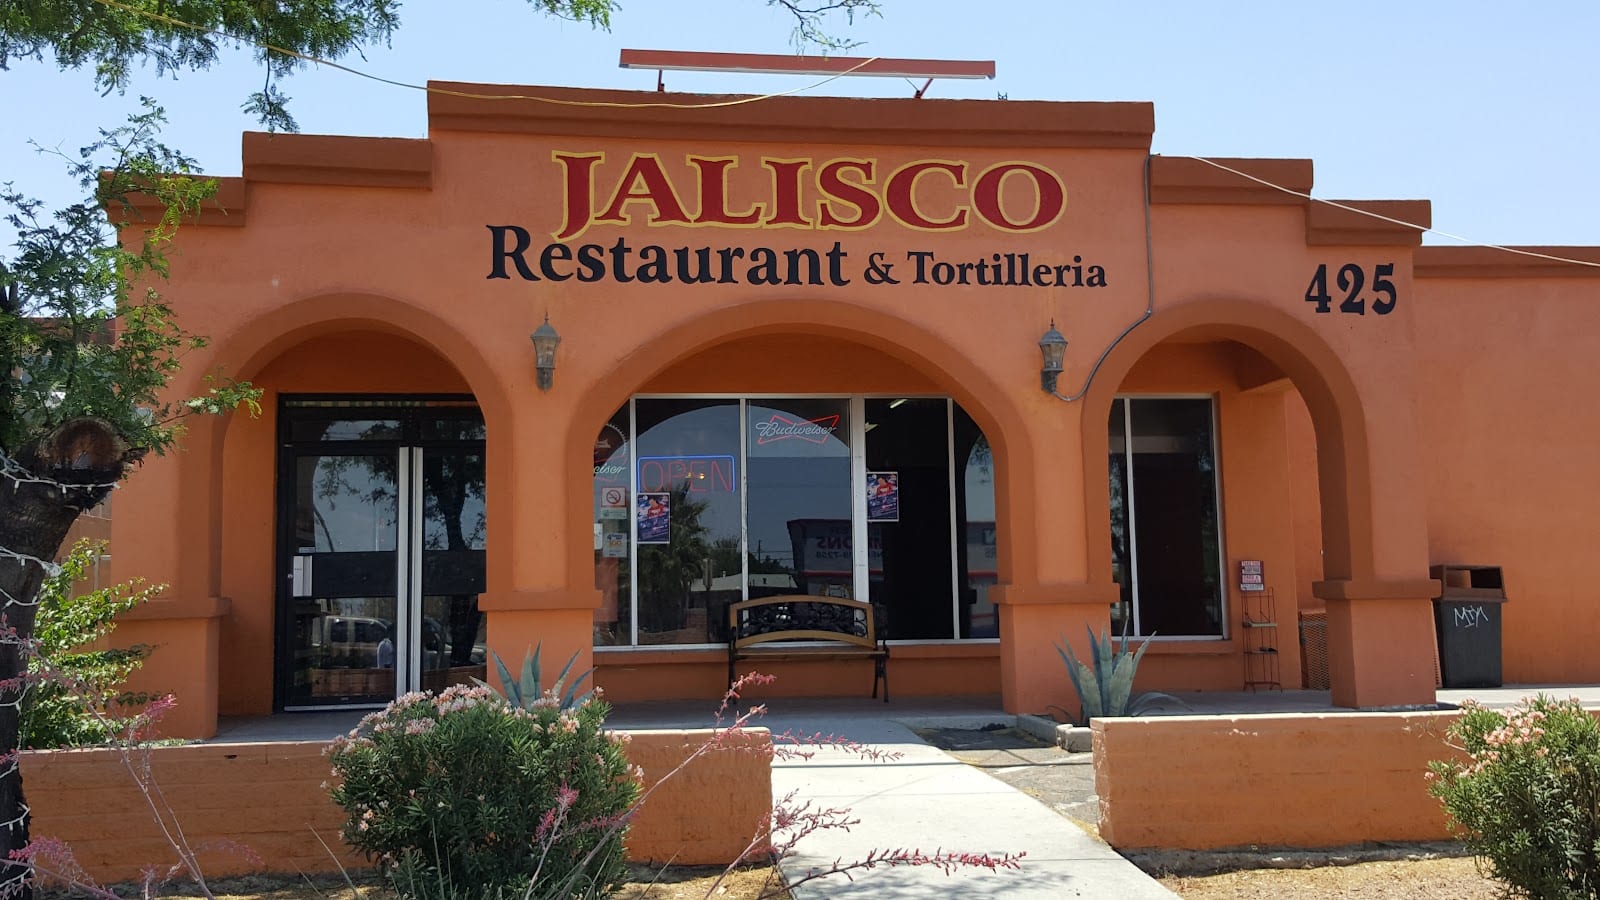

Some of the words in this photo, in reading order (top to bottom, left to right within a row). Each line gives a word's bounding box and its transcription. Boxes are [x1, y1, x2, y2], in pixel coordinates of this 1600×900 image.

[551, 151, 1065, 241] JALISCO
[485, 225, 849, 287] Restaurant
[864, 252, 901, 286] &
[907, 251, 1108, 287] Tortilleria
[1305, 263, 1397, 315] 425
[755, 422, 837, 437] Budweiser
[594, 462, 627, 475] eiser
[641, 460, 734, 493] OPEN
